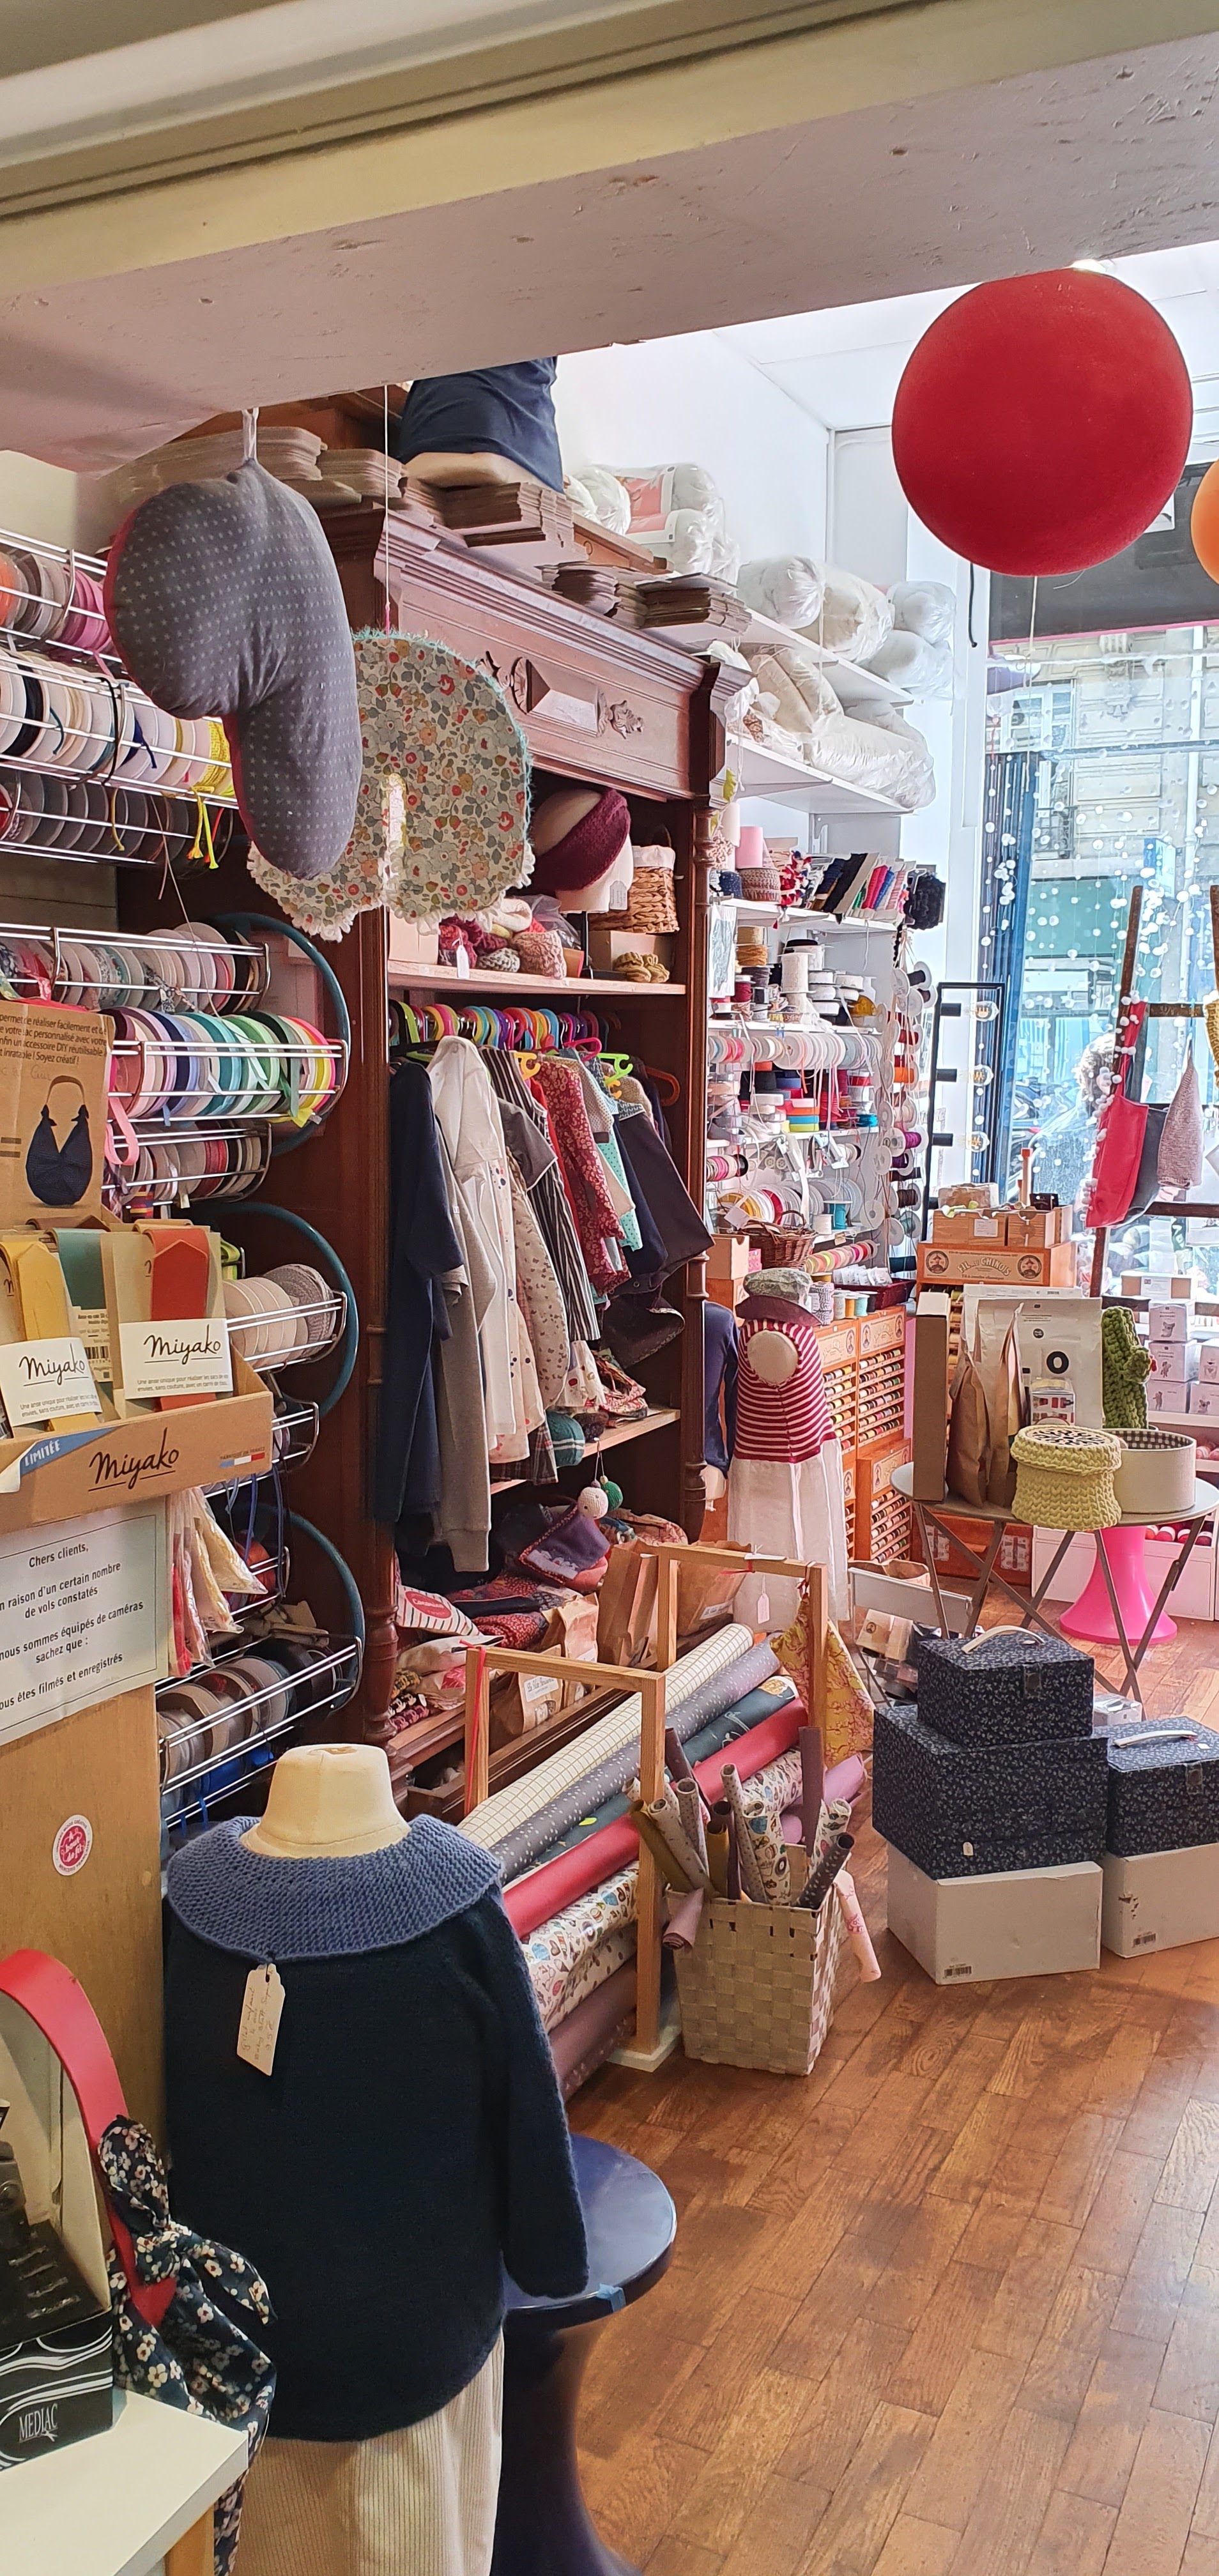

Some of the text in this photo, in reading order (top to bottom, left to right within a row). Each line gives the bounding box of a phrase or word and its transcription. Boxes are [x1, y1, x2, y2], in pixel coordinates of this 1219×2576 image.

[0, 1014, 23, 1023] permet
[33, 1018, 56, 1027] réaliser
[57, 1020, 91, 1032] facilement
[0, 1037, 13, 1046] nfin
[56, 1043, 68, 1052] DIY
[68, 1045, 103, 1057] réutilisable
[34, 1031, 74, 1041] personnalisé
[91, 1038, 107, 1046] votre
[36, 1051, 56, 1064] Soyez
[56, 1054, 76, 1064] créatif
[981, 1257, 1011, 1276] CHINOIS
[24, 1439, 61, 1466] LIMITÉE
[29, 1543, 89, 1568] Chers clients,
[0, 1563, 121, 1611] n raison d'un certain nombre
[25, 1586, 98, 1619] de vols constatés
[0, 1601, 144, 1661] nous sommes équipés de caméras
[36, 1645, 64, 1664] sachez
[66, 1638, 83, 1654] que
[0, 1653, 123, 1710] ous êtes filmés et enregistrés
[19, 2403, 58, 2439] MEDIAC
